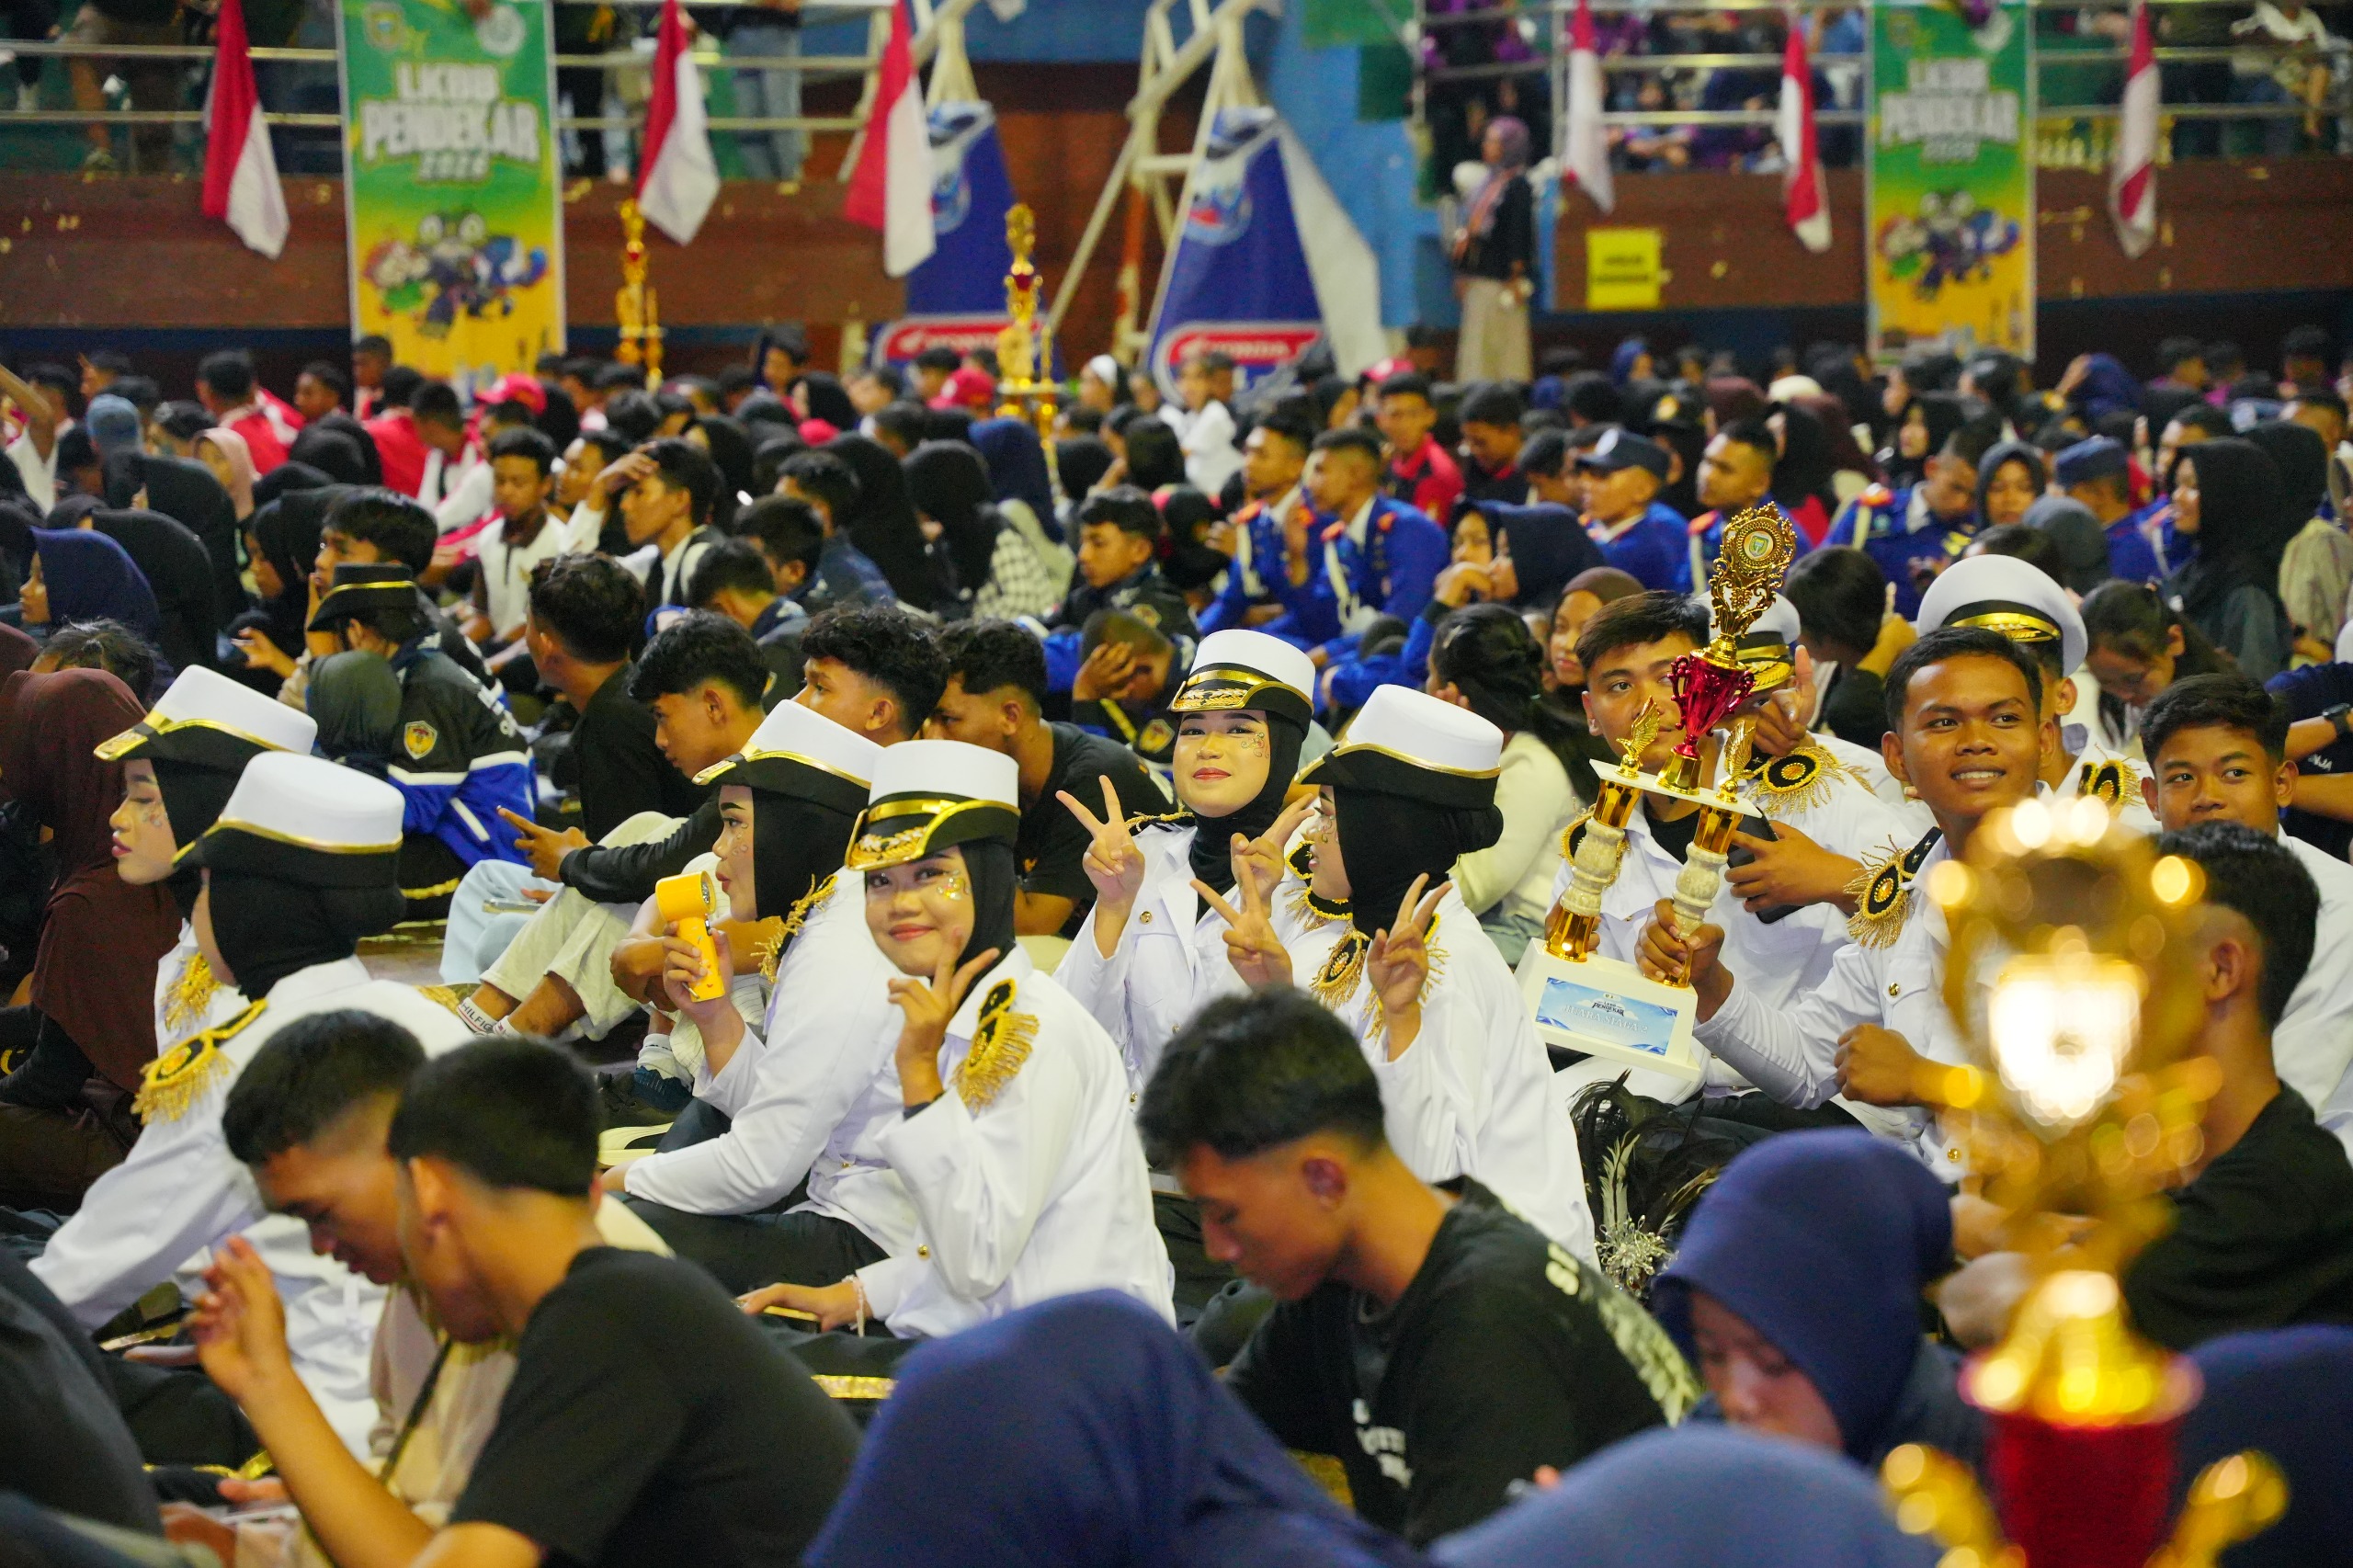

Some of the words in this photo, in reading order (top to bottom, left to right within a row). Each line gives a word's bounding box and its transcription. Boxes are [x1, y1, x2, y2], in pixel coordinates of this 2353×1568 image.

[361, 99, 539, 162] PENDEKAR
[461, 1003, 496, 1030] HILFIG
[1603, 1016, 1639, 1032] SIAGA
[1641, 1025, 1648, 1033] 2
